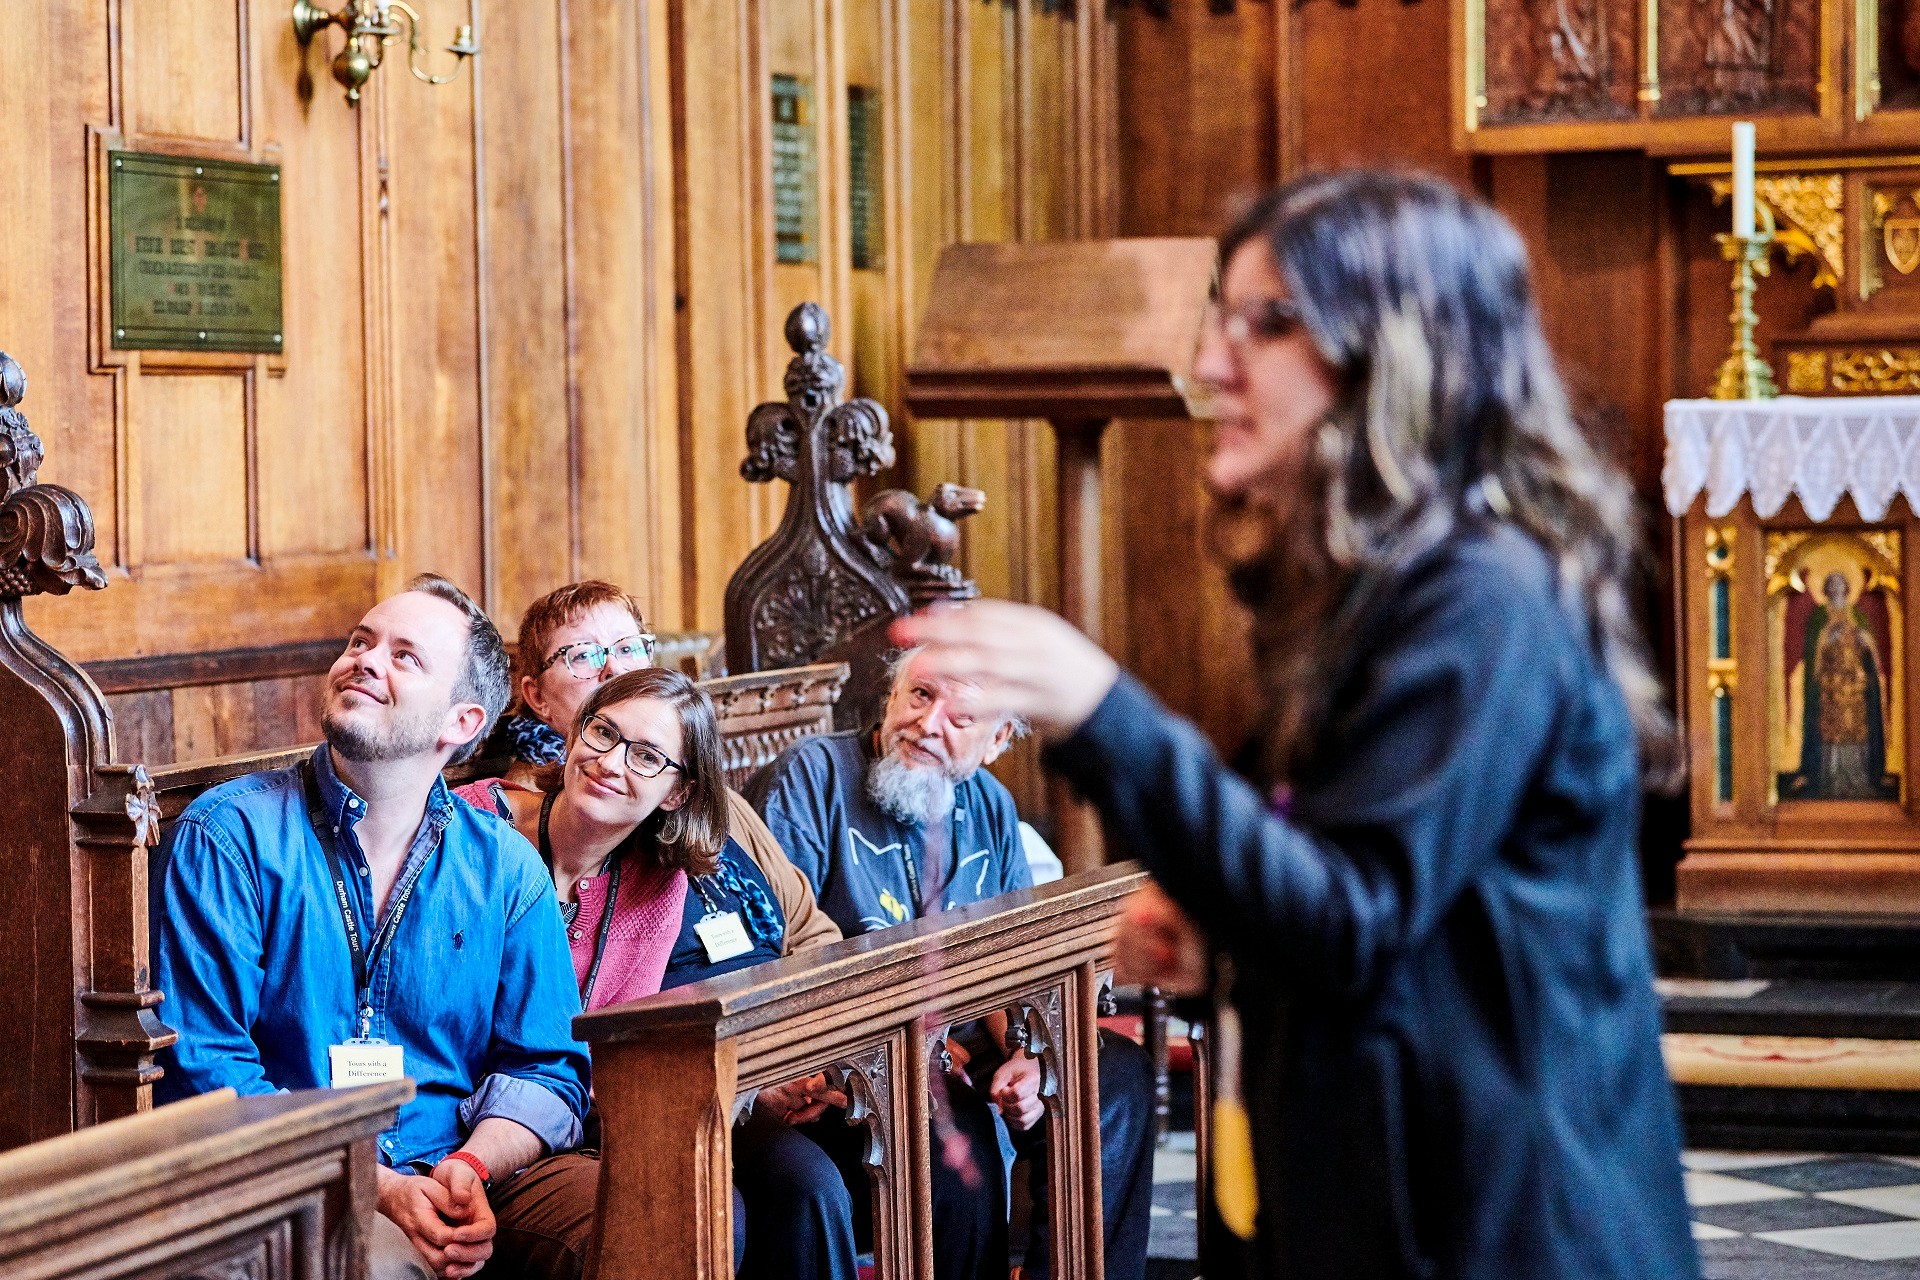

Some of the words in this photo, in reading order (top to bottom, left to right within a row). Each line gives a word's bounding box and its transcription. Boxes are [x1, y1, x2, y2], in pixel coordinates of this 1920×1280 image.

[336, 880, 348, 908] Durham
[344, 909, 355, 931] Castle
[350, 931, 360, 952] Tours
[383, 924, 397, 951] Durham
[393, 902, 406, 924] Castle
[602, 909, 613, 934] Durham
[609, 887, 617, 908] Castle
[586, 977, 595, 997] Castle
[592, 959, 600, 976] Tours
